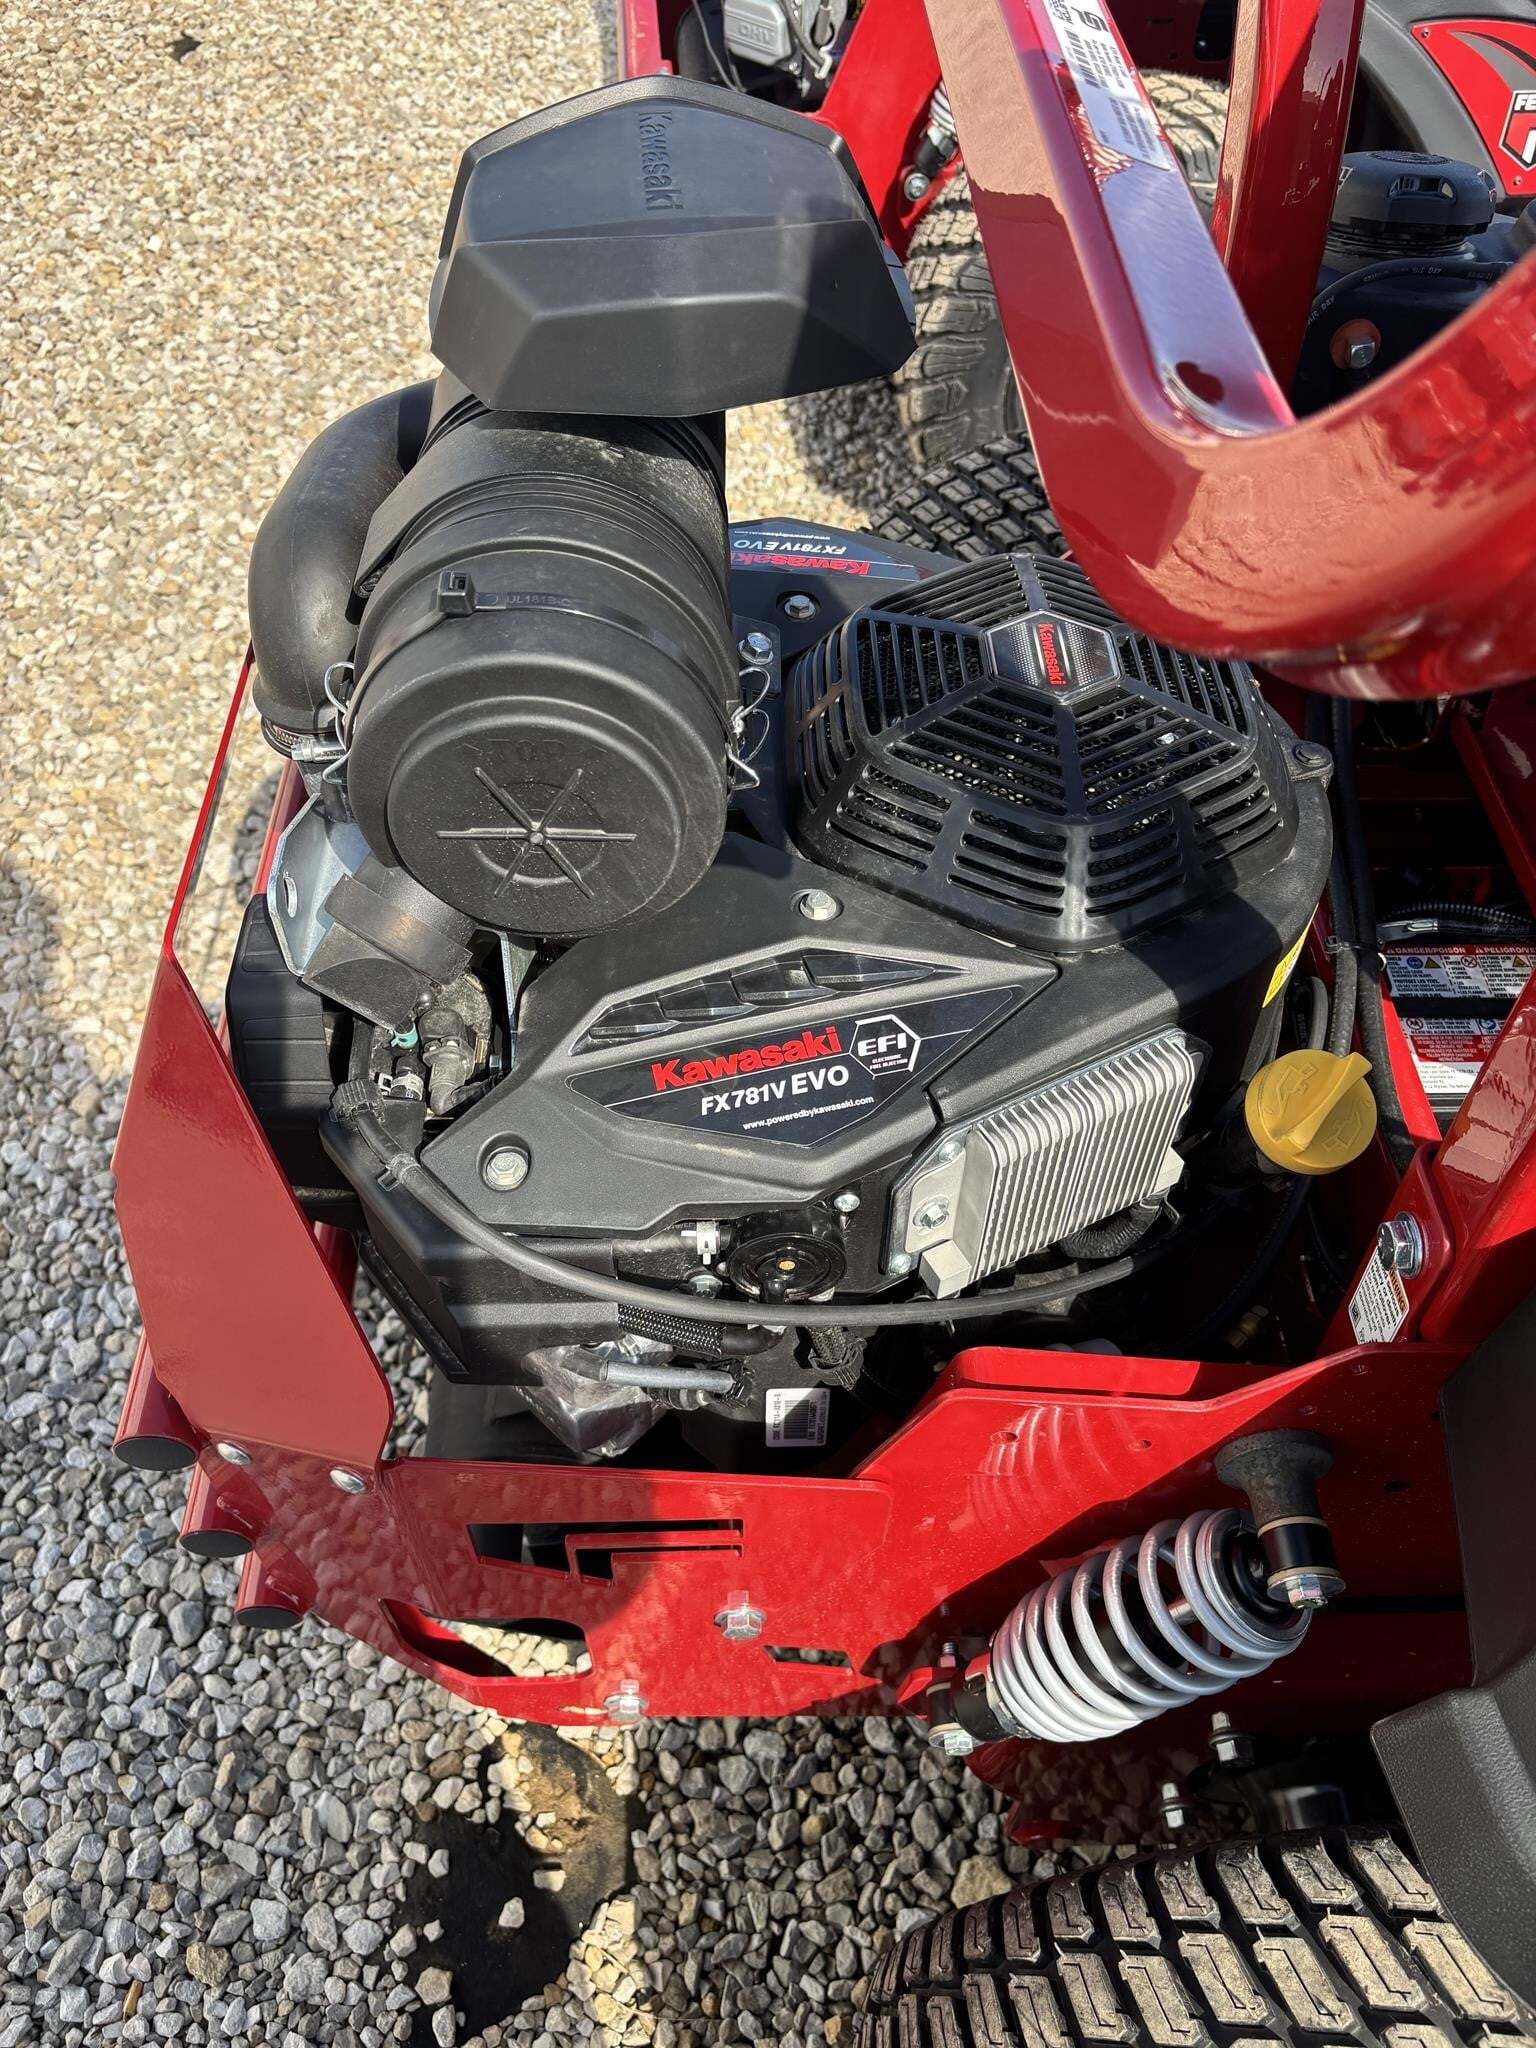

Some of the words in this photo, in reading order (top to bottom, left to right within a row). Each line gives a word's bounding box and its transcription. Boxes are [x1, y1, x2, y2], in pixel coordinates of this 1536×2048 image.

[637, 111, 684, 211] Kawasaki
[733, 539, 776, 551] EVO
[779, 542, 847, 555] FX781V
[1038, 623, 1066, 685] Kawasaki
[651, 1026, 842, 1091] Kawasaki
[857, 1032, 907, 1056] EFI
[701, 1079, 786, 1116] FX781V
[791, 1065, 849, 1095] EVO
[742, 1095, 875, 1130] www.poweredbykawasaki.com
